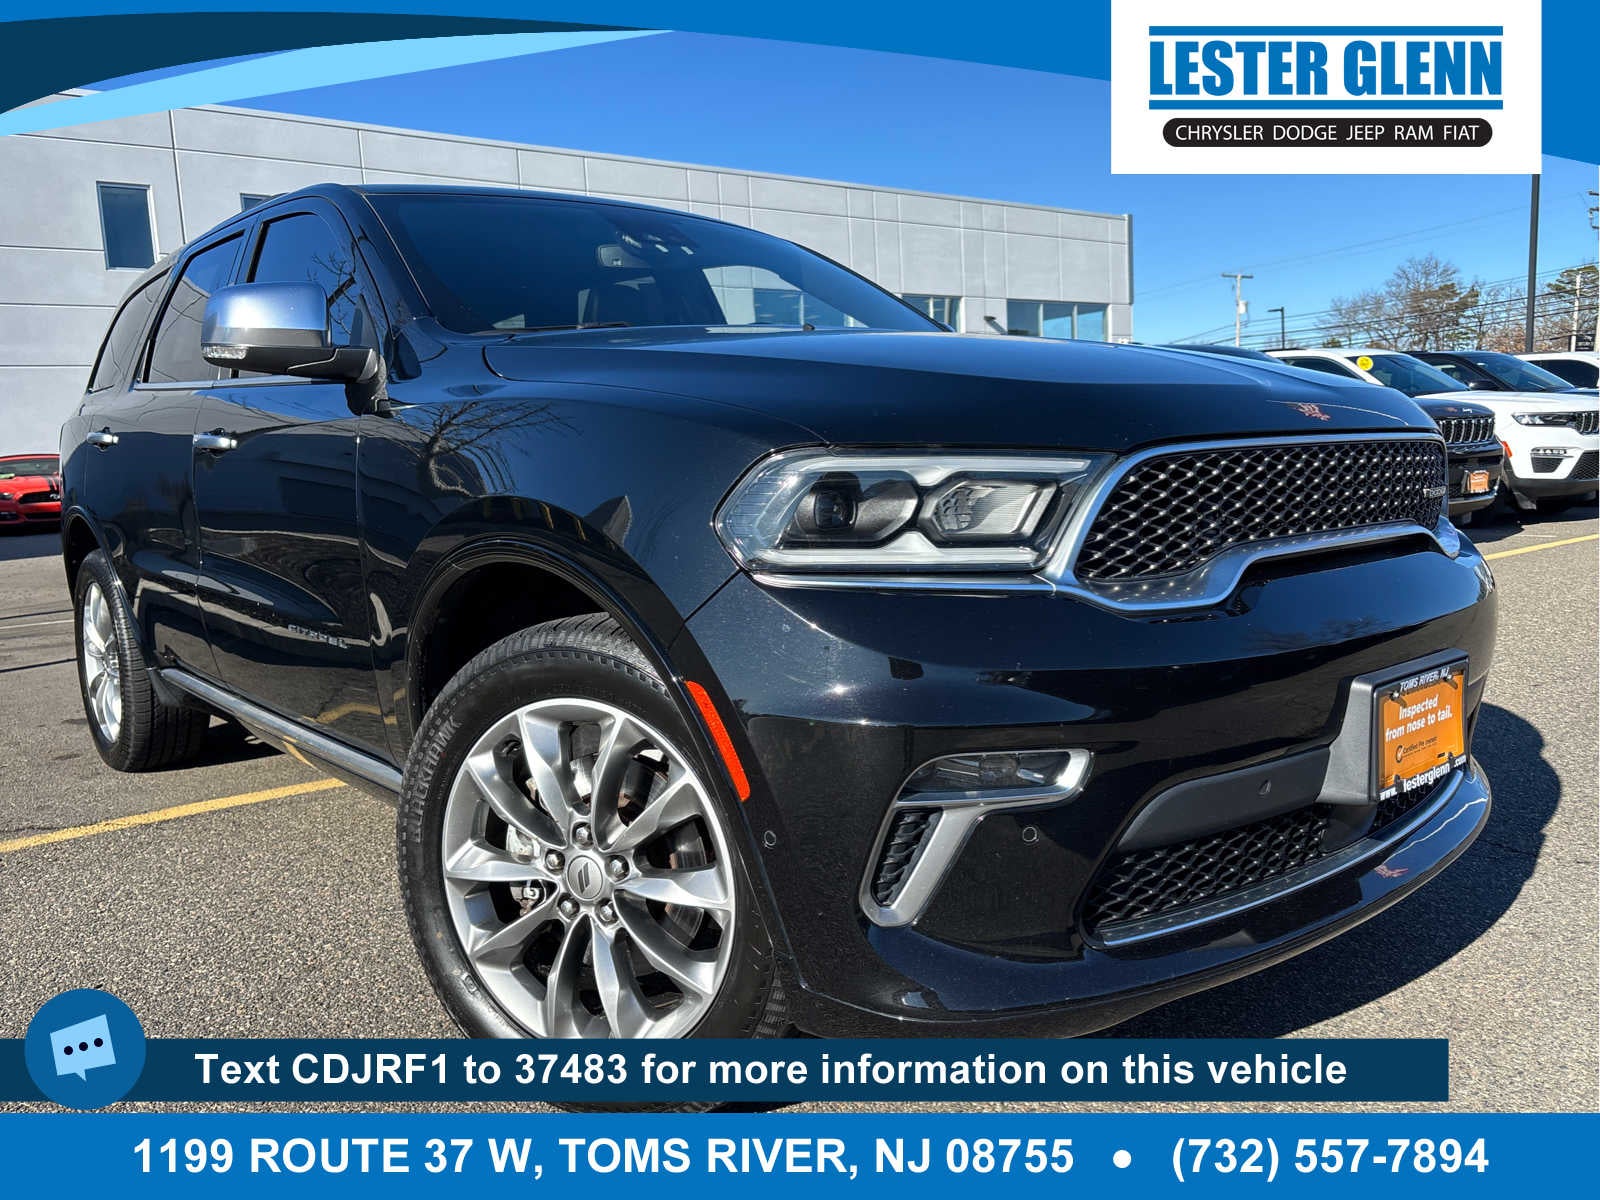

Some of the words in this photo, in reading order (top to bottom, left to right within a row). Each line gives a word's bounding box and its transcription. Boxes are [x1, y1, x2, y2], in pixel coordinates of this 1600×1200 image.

[1399, 677, 1419, 693] TOMS
[1399, 694, 1439, 720] Inspected
[1385, 725, 1405, 743] from
[1406, 717, 1426, 734] nose
[1427, 713, 1436, 726] to
[1403, 763, 1450, 793] lesterglenn
